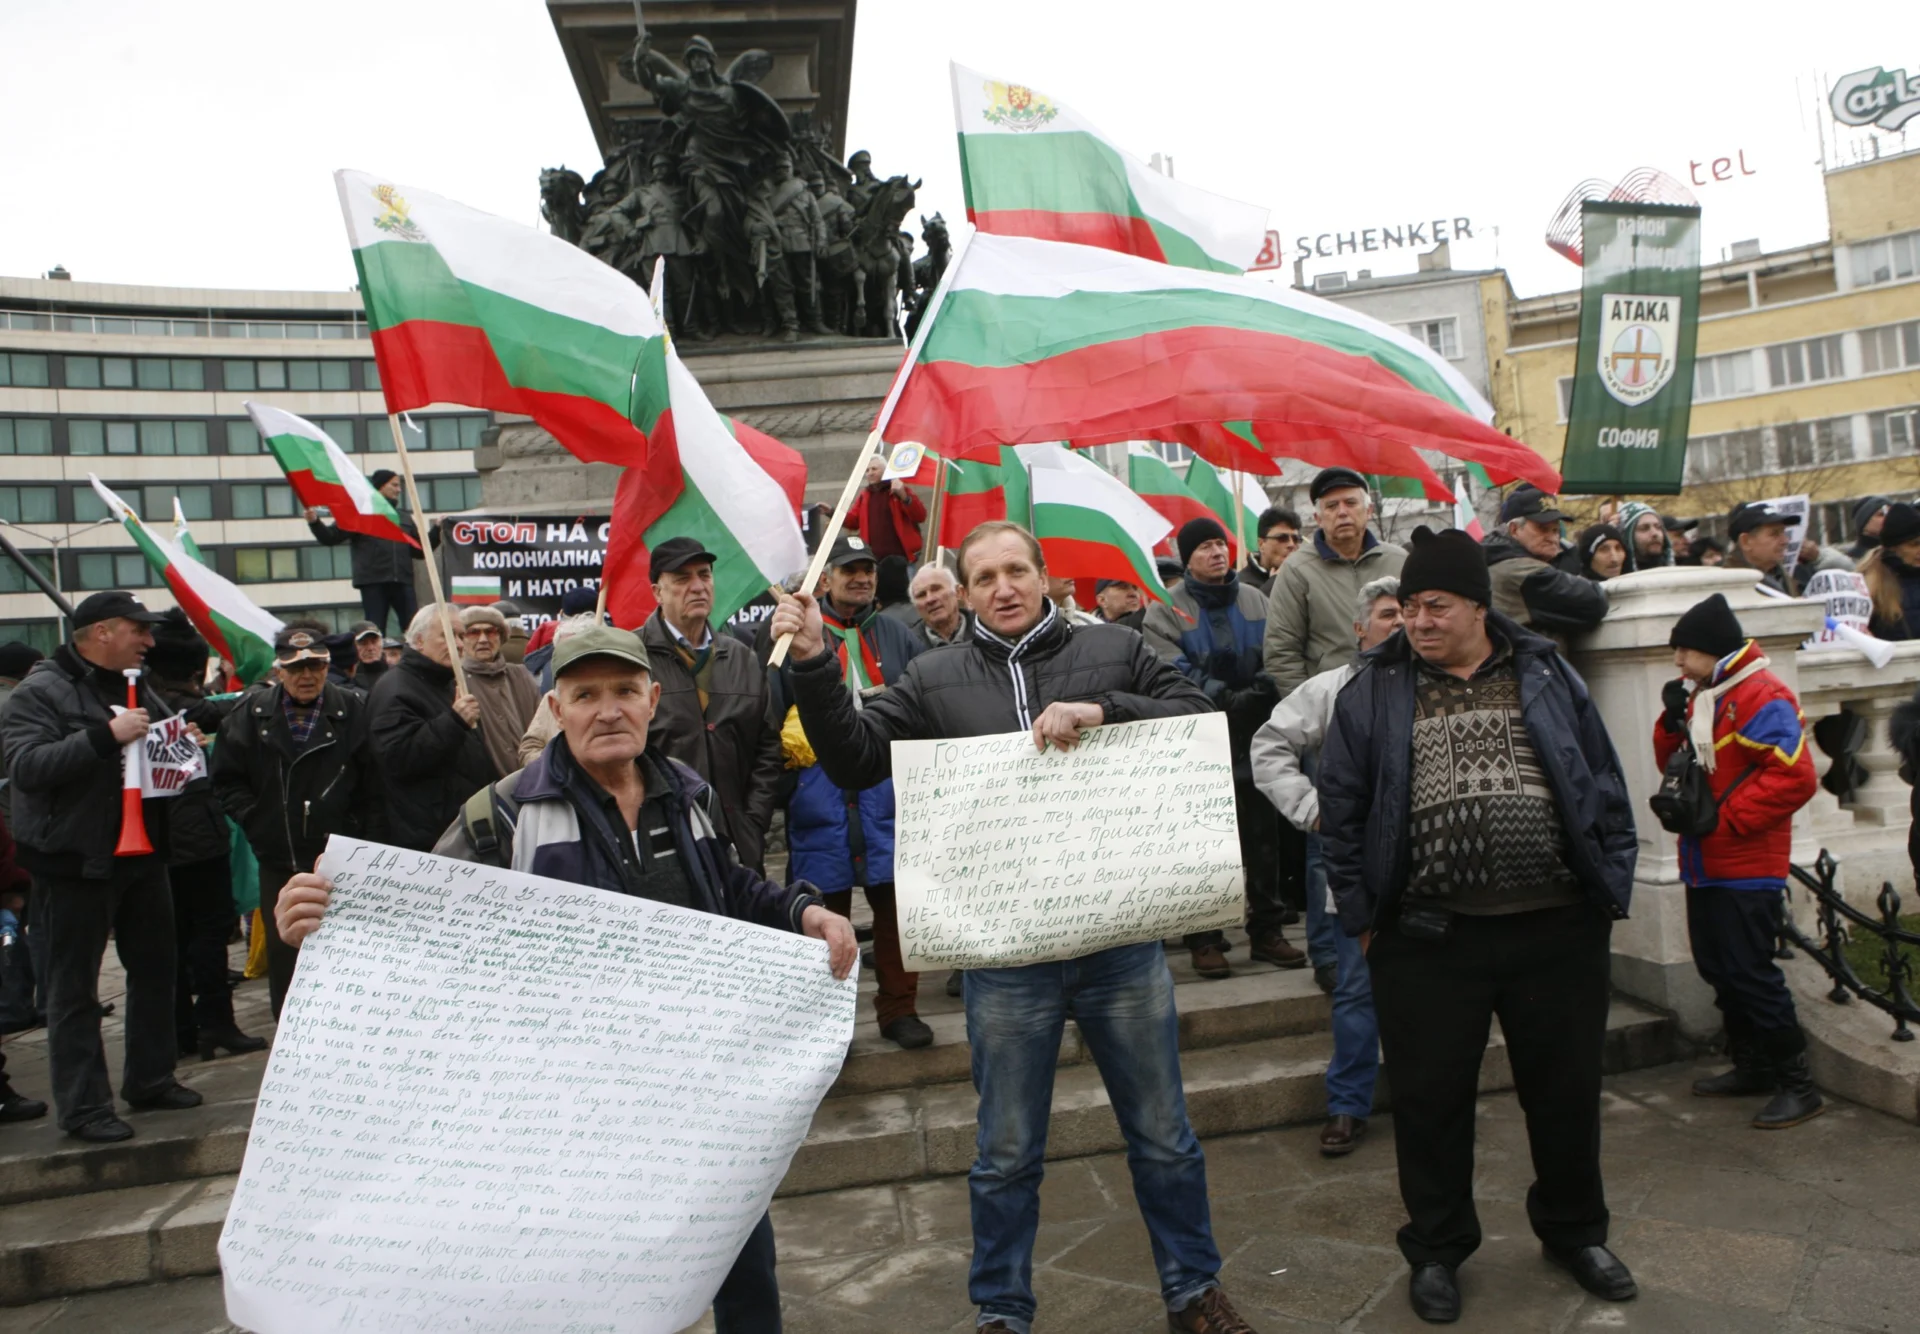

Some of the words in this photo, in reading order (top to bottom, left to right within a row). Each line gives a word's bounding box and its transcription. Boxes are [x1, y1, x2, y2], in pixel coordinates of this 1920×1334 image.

[1689, 149, 1756, 186] tel
[1296, 217, 1473, 259] SCHENKER
[1611, 300, 1669, 322] АТАКА
[1597, 427, 1659, 449] СОФИЯ
[452, 521, 537, 544] СТОП
[546, 523, 588, 543] НА
[509, 581, 522, 597] И
[528, 578, 577, 597] НАТО
